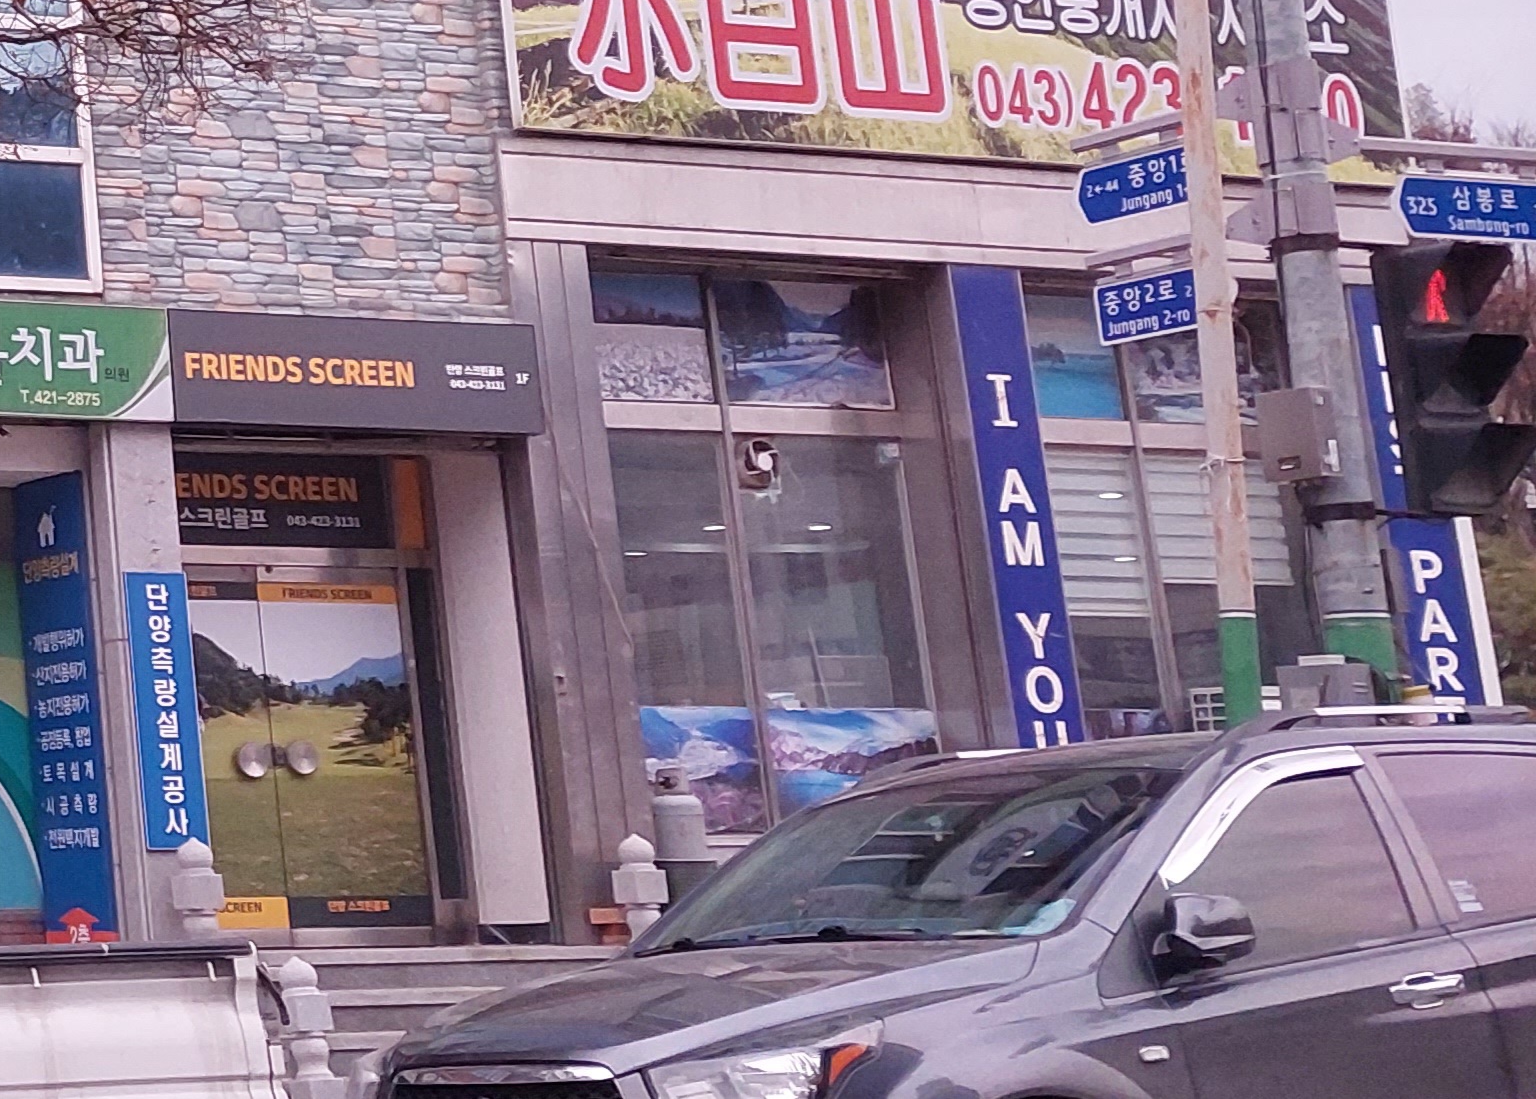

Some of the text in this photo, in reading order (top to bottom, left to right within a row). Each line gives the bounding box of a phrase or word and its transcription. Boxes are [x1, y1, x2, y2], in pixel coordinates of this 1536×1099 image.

[1121, 188, 1173, 212] Jungang
[1406, 196, 1438, 215] 325
[1452, 186, 1519, 213] 삼봉로
[1448, 215, 1529, 236] Sambong-ro
[1102, 280, 1177, 315] 중앙2로
[1107, 309, 1190, 336] Jungang 2-ro
[184, 351, 416, 389] FRIENDS SCREEN
[985, 373, 1019, 428] I
[254, 473, 359, 503] SCREEN
[281, 586, 373, 601] FRIENDS SCREEN
[145, 583, 189, 836] 단양측량설계공사
